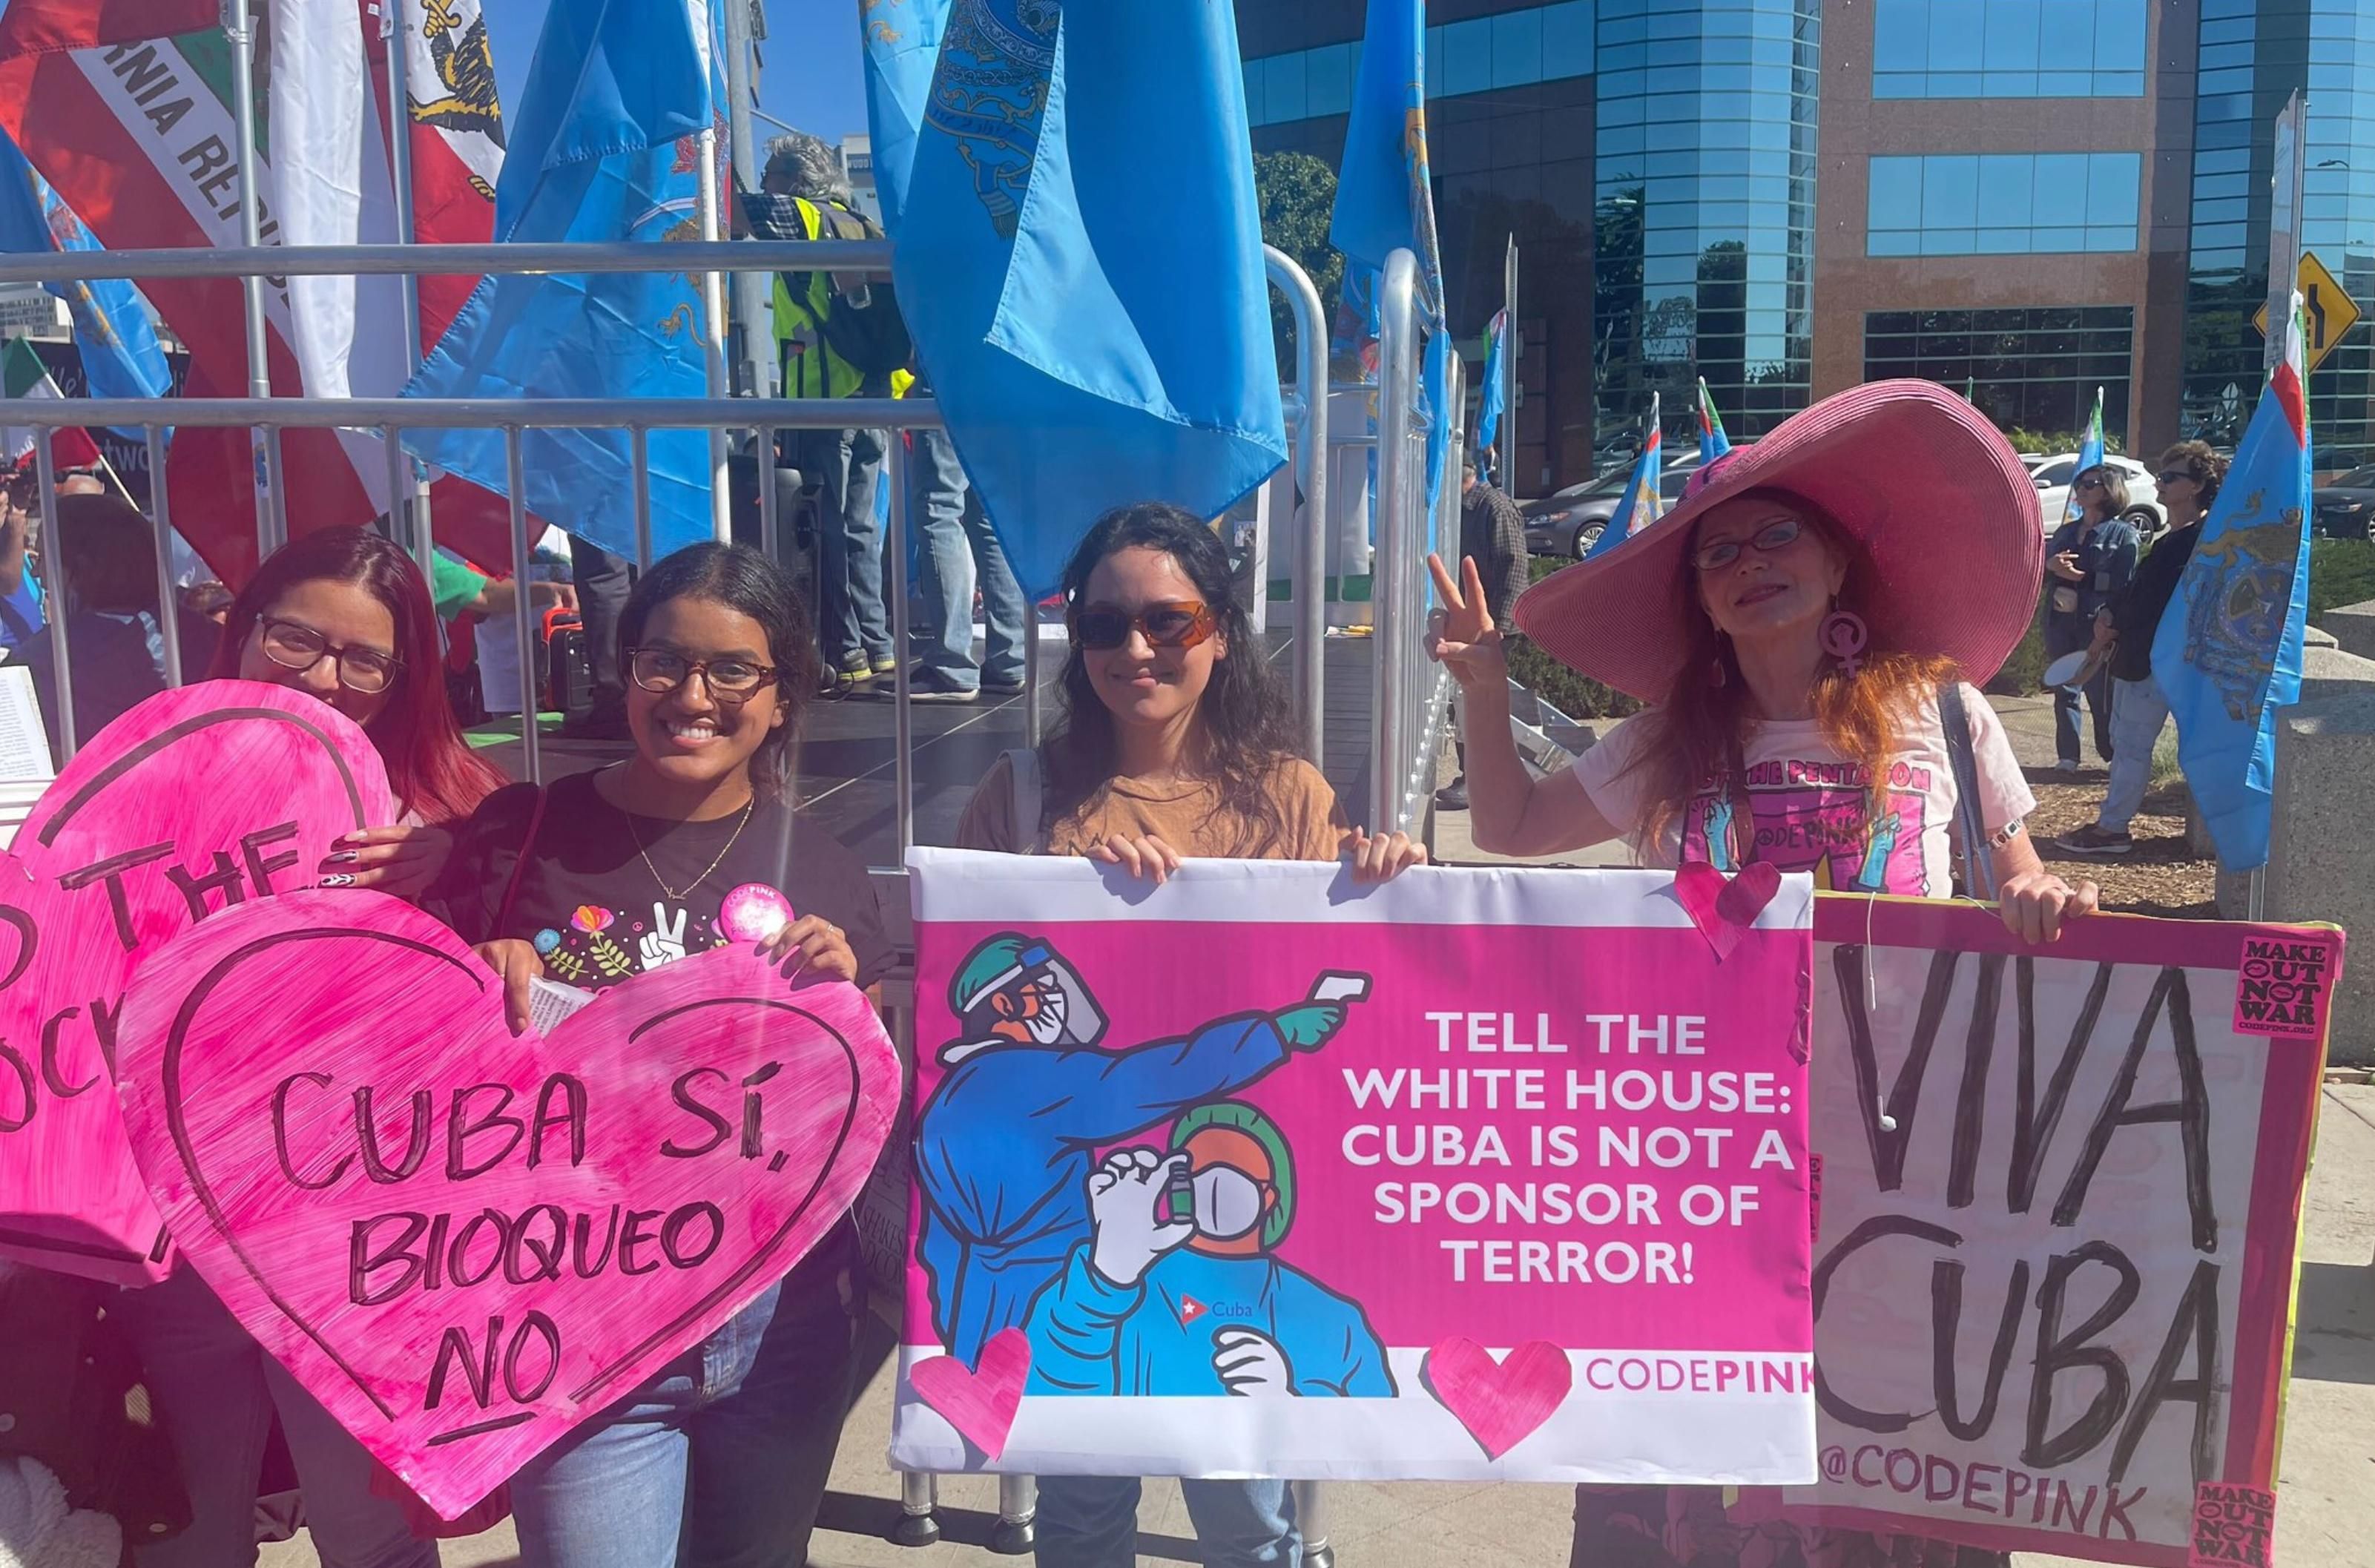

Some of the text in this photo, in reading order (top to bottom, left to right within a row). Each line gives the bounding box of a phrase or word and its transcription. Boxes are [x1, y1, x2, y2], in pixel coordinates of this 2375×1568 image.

[1745, 761, 1783, 785] HE
[1788, 760, 1931, 792] PENTAON
[55, 820, 314, 953] THE
[2244, 958, 2325, 983] OUT
[2245, 941, 2327, 963] MAKE
[2239, 1001, 2316, 1025] WAR
[2240, 978, 2322, 1005] NOT
[1426, 1012, 1705, 1055] TELL THE
[1341, 1068, 1791, 1114] WHITE HOUSE:
[1833, 942, 2218, 1254] VIVA
[271, 1072, 587, 1190] CUBA
[1341, 1124, 1795, 1170] CUBA IS NOT A
[1374, 1182, 1661, 1225] SPONSOR
[1679, 1185, 1759, 1226] OF
[1440, 1240, 1694, 1285] TERROR!
[1212, 1301, 1252, 1317] Cuba
[424, 1310, 561, 1411] NO
[1813, 1213, 2222, 1491] CUBA
[1818, 1444, 2148, 1542] @CODEPINK
[2198, 1501, 2273, 1526] OUT
[2201, 1486, 2273, 1509] MAKE
[2194, 1538, 2264, 1568] WAR
[2195, 1518, 2270, 1546] NOT
